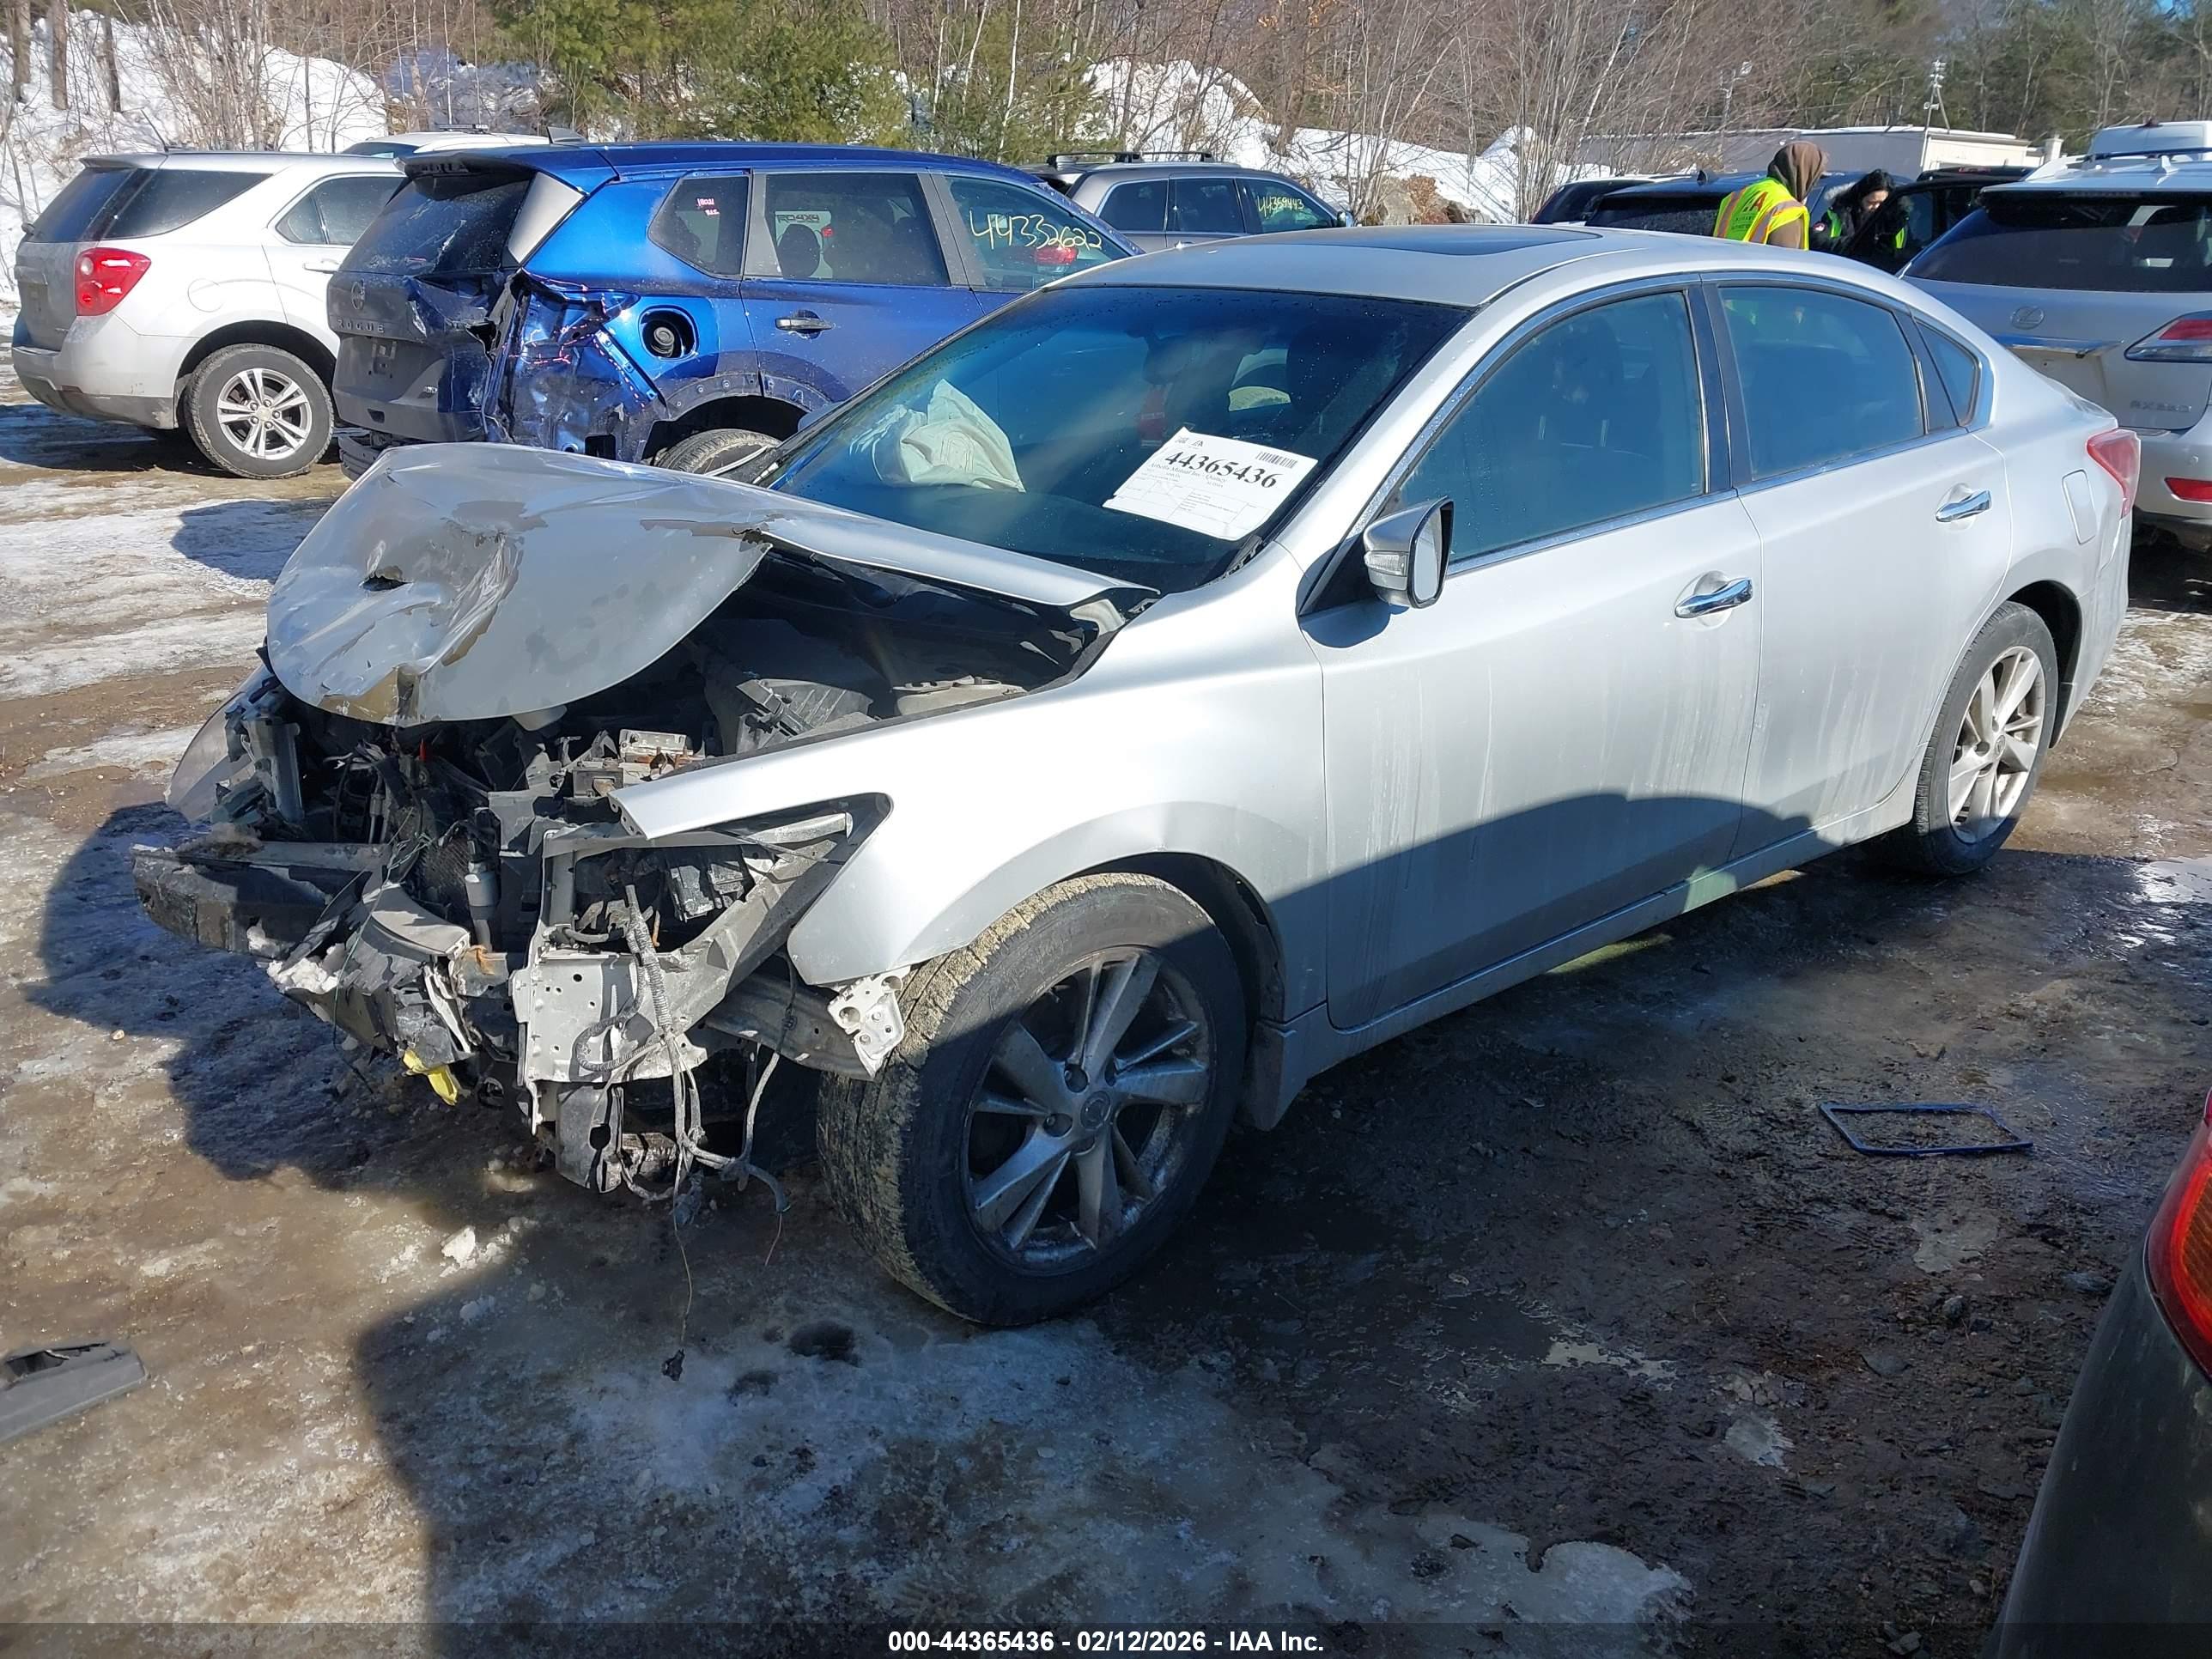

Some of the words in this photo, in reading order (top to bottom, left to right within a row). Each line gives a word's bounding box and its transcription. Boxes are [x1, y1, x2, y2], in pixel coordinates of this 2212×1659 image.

[1256, 195, 1304, 217] 44359443
[969, 210, 1103, 250] 44332622
[337, 319, 386, 333] ROGUE
[1164, 451, 1284, 489] 44365436
